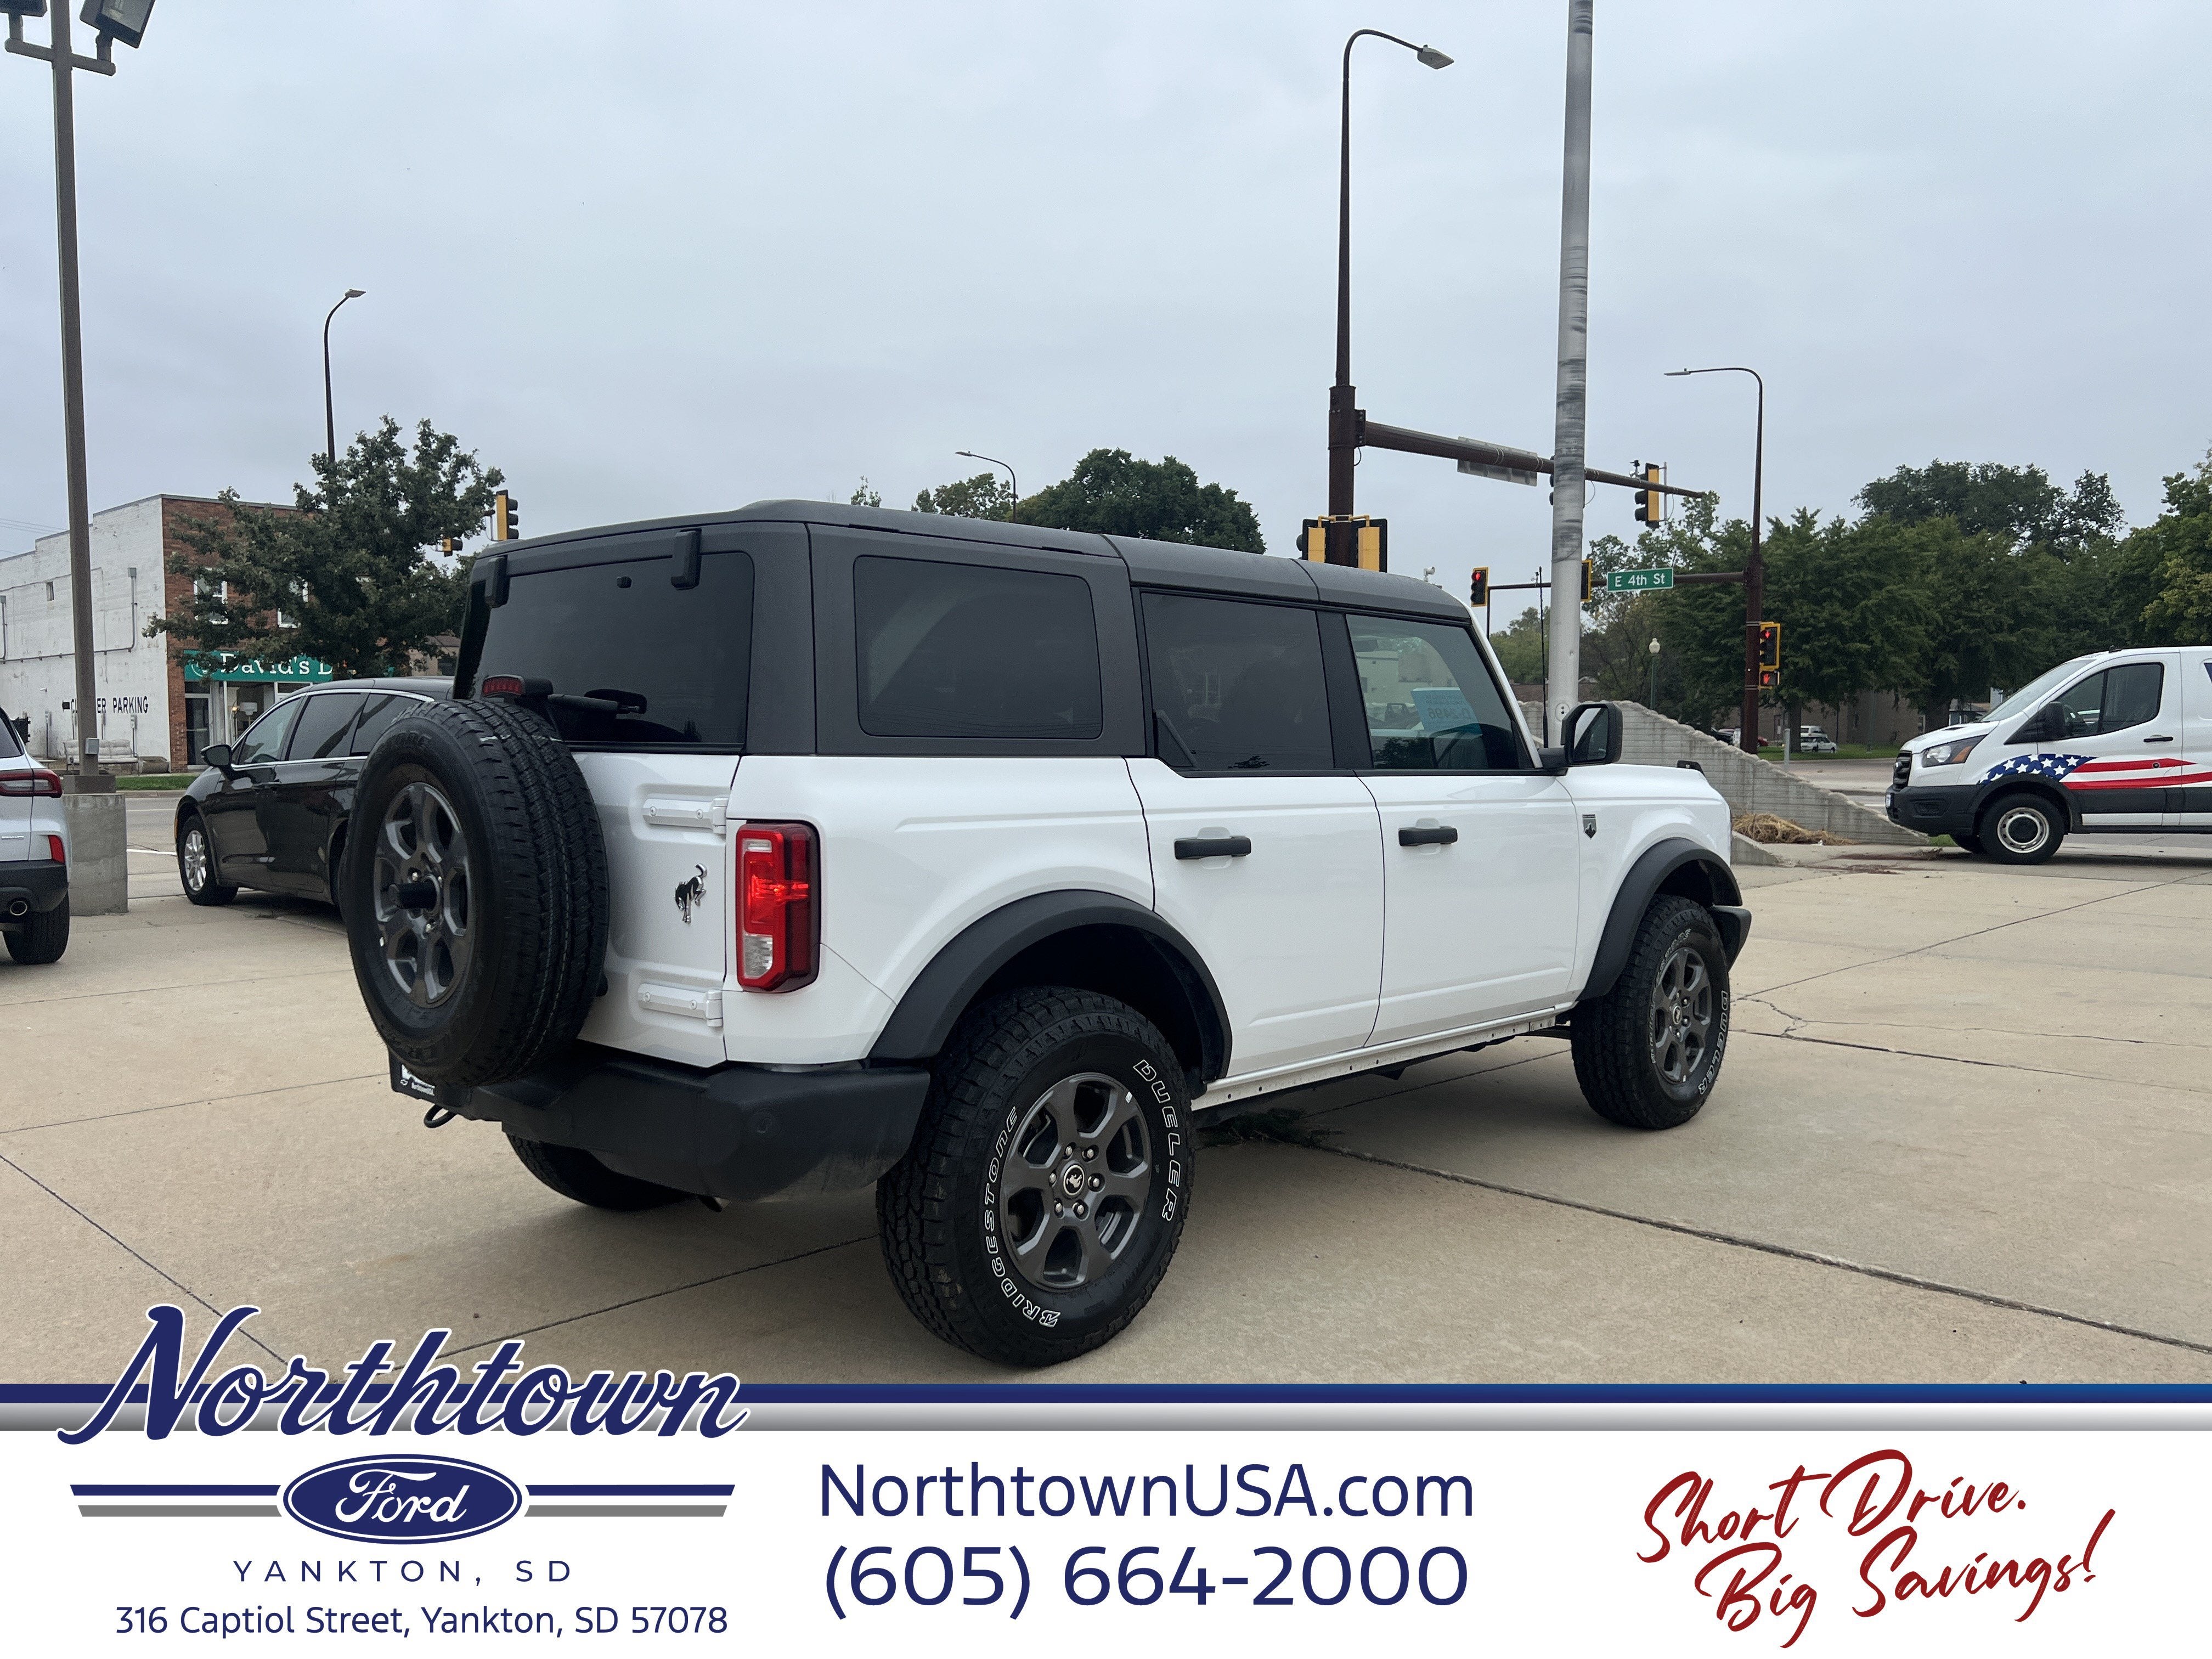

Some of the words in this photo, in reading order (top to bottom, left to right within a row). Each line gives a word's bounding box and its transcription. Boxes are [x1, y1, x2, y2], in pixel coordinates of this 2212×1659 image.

[1615, 575, 1622, 587] E
[1628, 574, 1647, 586] 4th
[1653, 573, 1666, 585] St
[112, 696, 149, 714] PARKING
[1697, 990, 1728, 1095] DUELER
[1133, 1059, 1181, 1221] DUELER
[985, 1106, 1061, 1328] BRIDGESTONE
